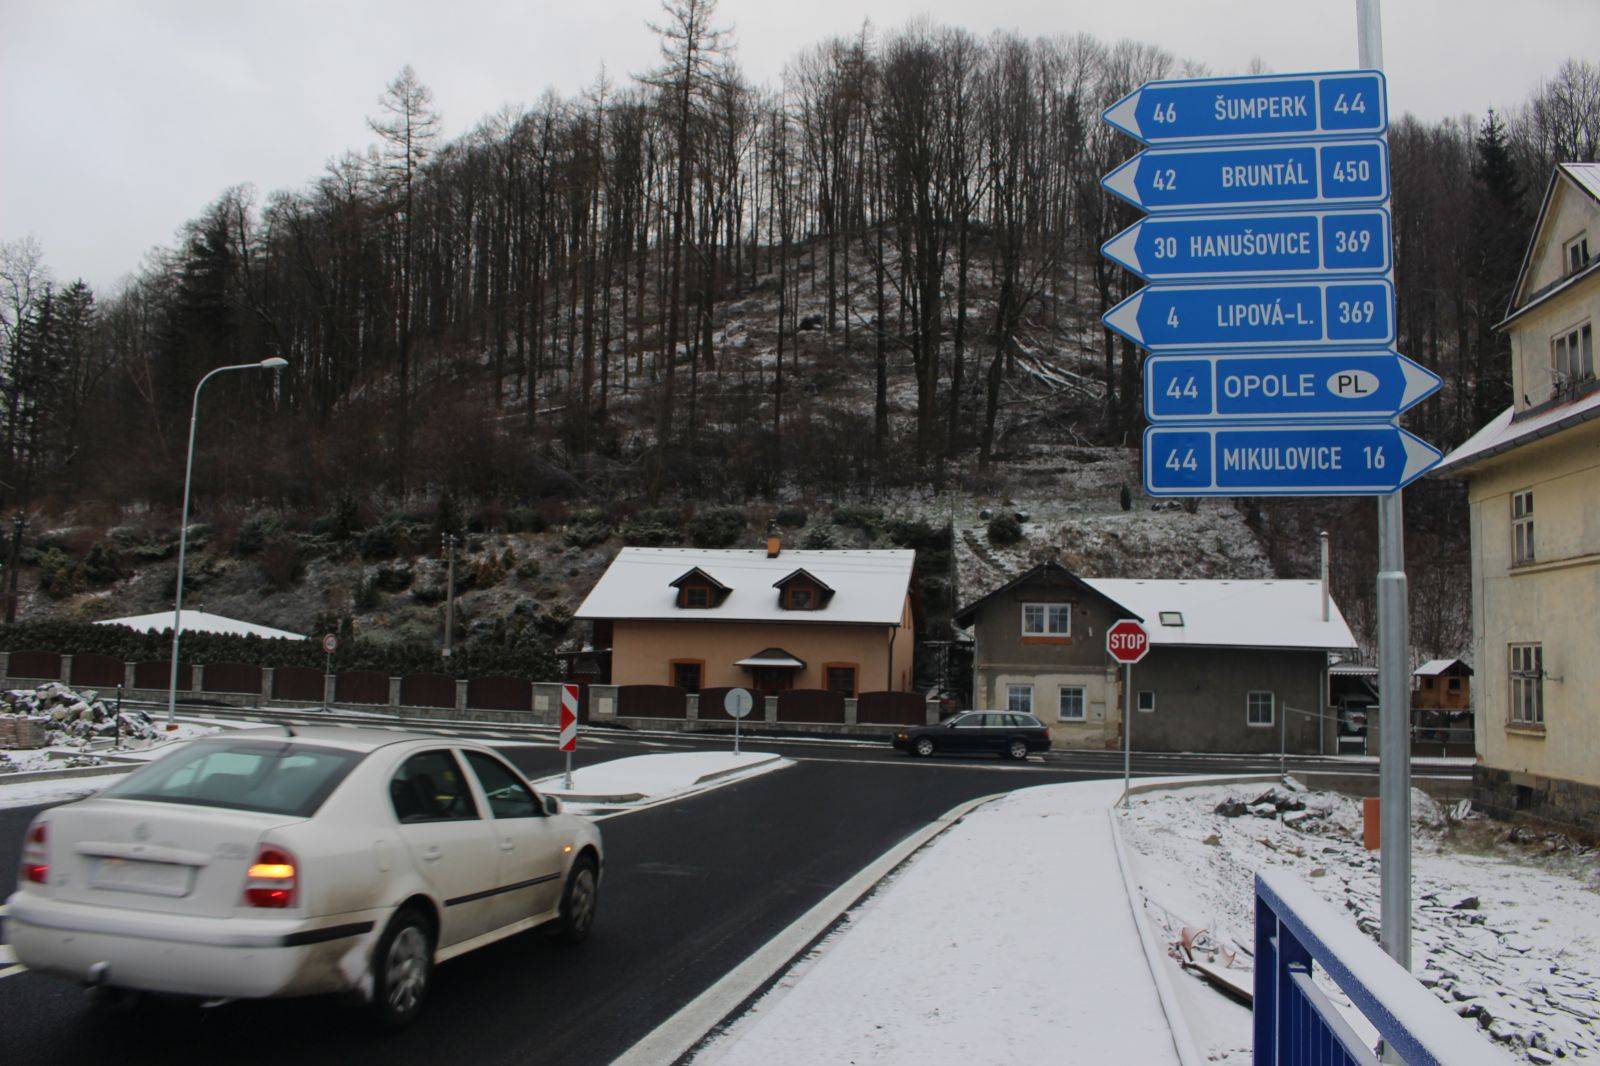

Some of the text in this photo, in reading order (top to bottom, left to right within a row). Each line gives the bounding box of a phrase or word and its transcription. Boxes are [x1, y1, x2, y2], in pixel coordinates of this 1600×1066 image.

[1153, 92, 1366, 123] 46 ŠUMPERK 44
[1153, 158, 1370, 190] 42 BRUNTÁL 450
[1154, 229, 1371, 258] 30 HANUŠOVICE 369
[1167, 298, 1374, 328] 4 LIPOVÁ-L. 369
[1166, 373, 1368, 399] 44 OPOLE PL
[1165, 446, 1386, 471] 44 MIKULOVICE 16
[1110, 633, 1145, 650] STOP
